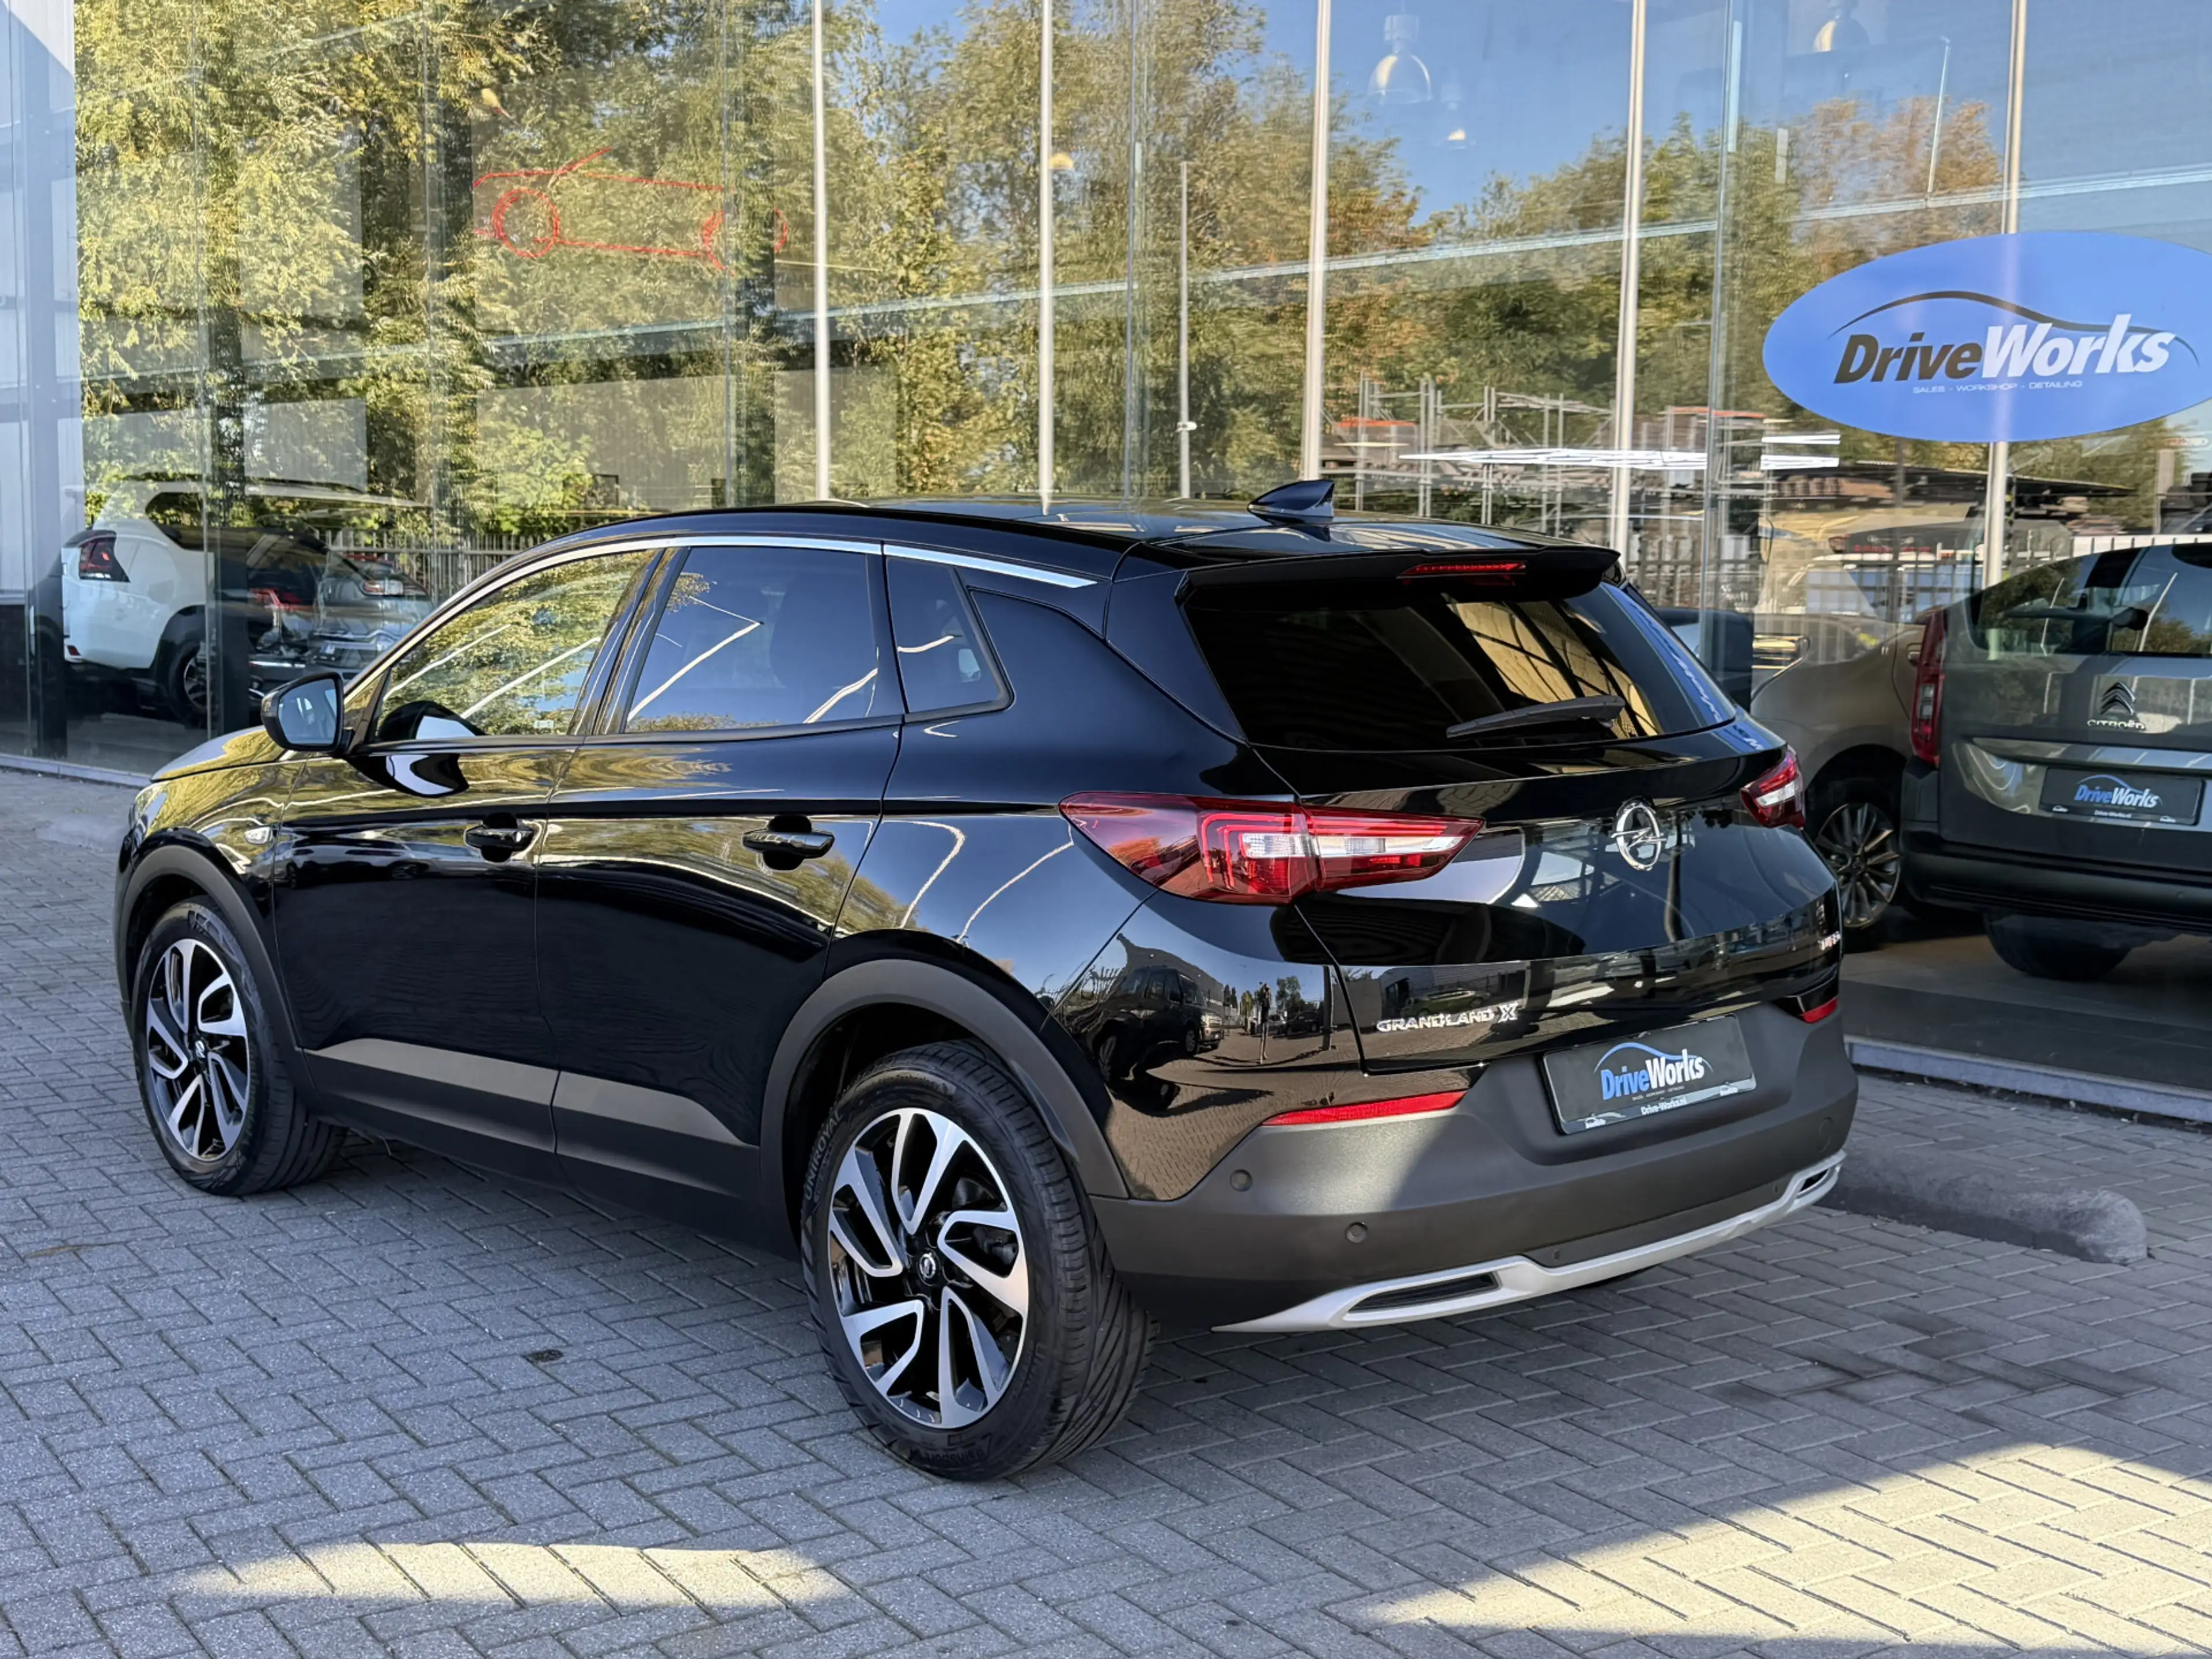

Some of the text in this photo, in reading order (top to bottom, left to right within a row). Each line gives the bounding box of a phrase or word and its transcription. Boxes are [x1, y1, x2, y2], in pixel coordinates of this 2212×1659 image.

[1833, 313, 2176, 385] DriveWorks
[1912, 385, 1945, 393] SALES
[1956, 382, 2018, 392] WORKSHOP
[2029, 380, 2083, 389] DETAILING
[2074, 784, 2160, 808] DriveWorks
[1376, 1002, 1519, 1032] GRANDLAND X
[1601, 1048, 1705, 1100] DriveWorks
[804, 1109, 844, 1201] UNIROYAL
